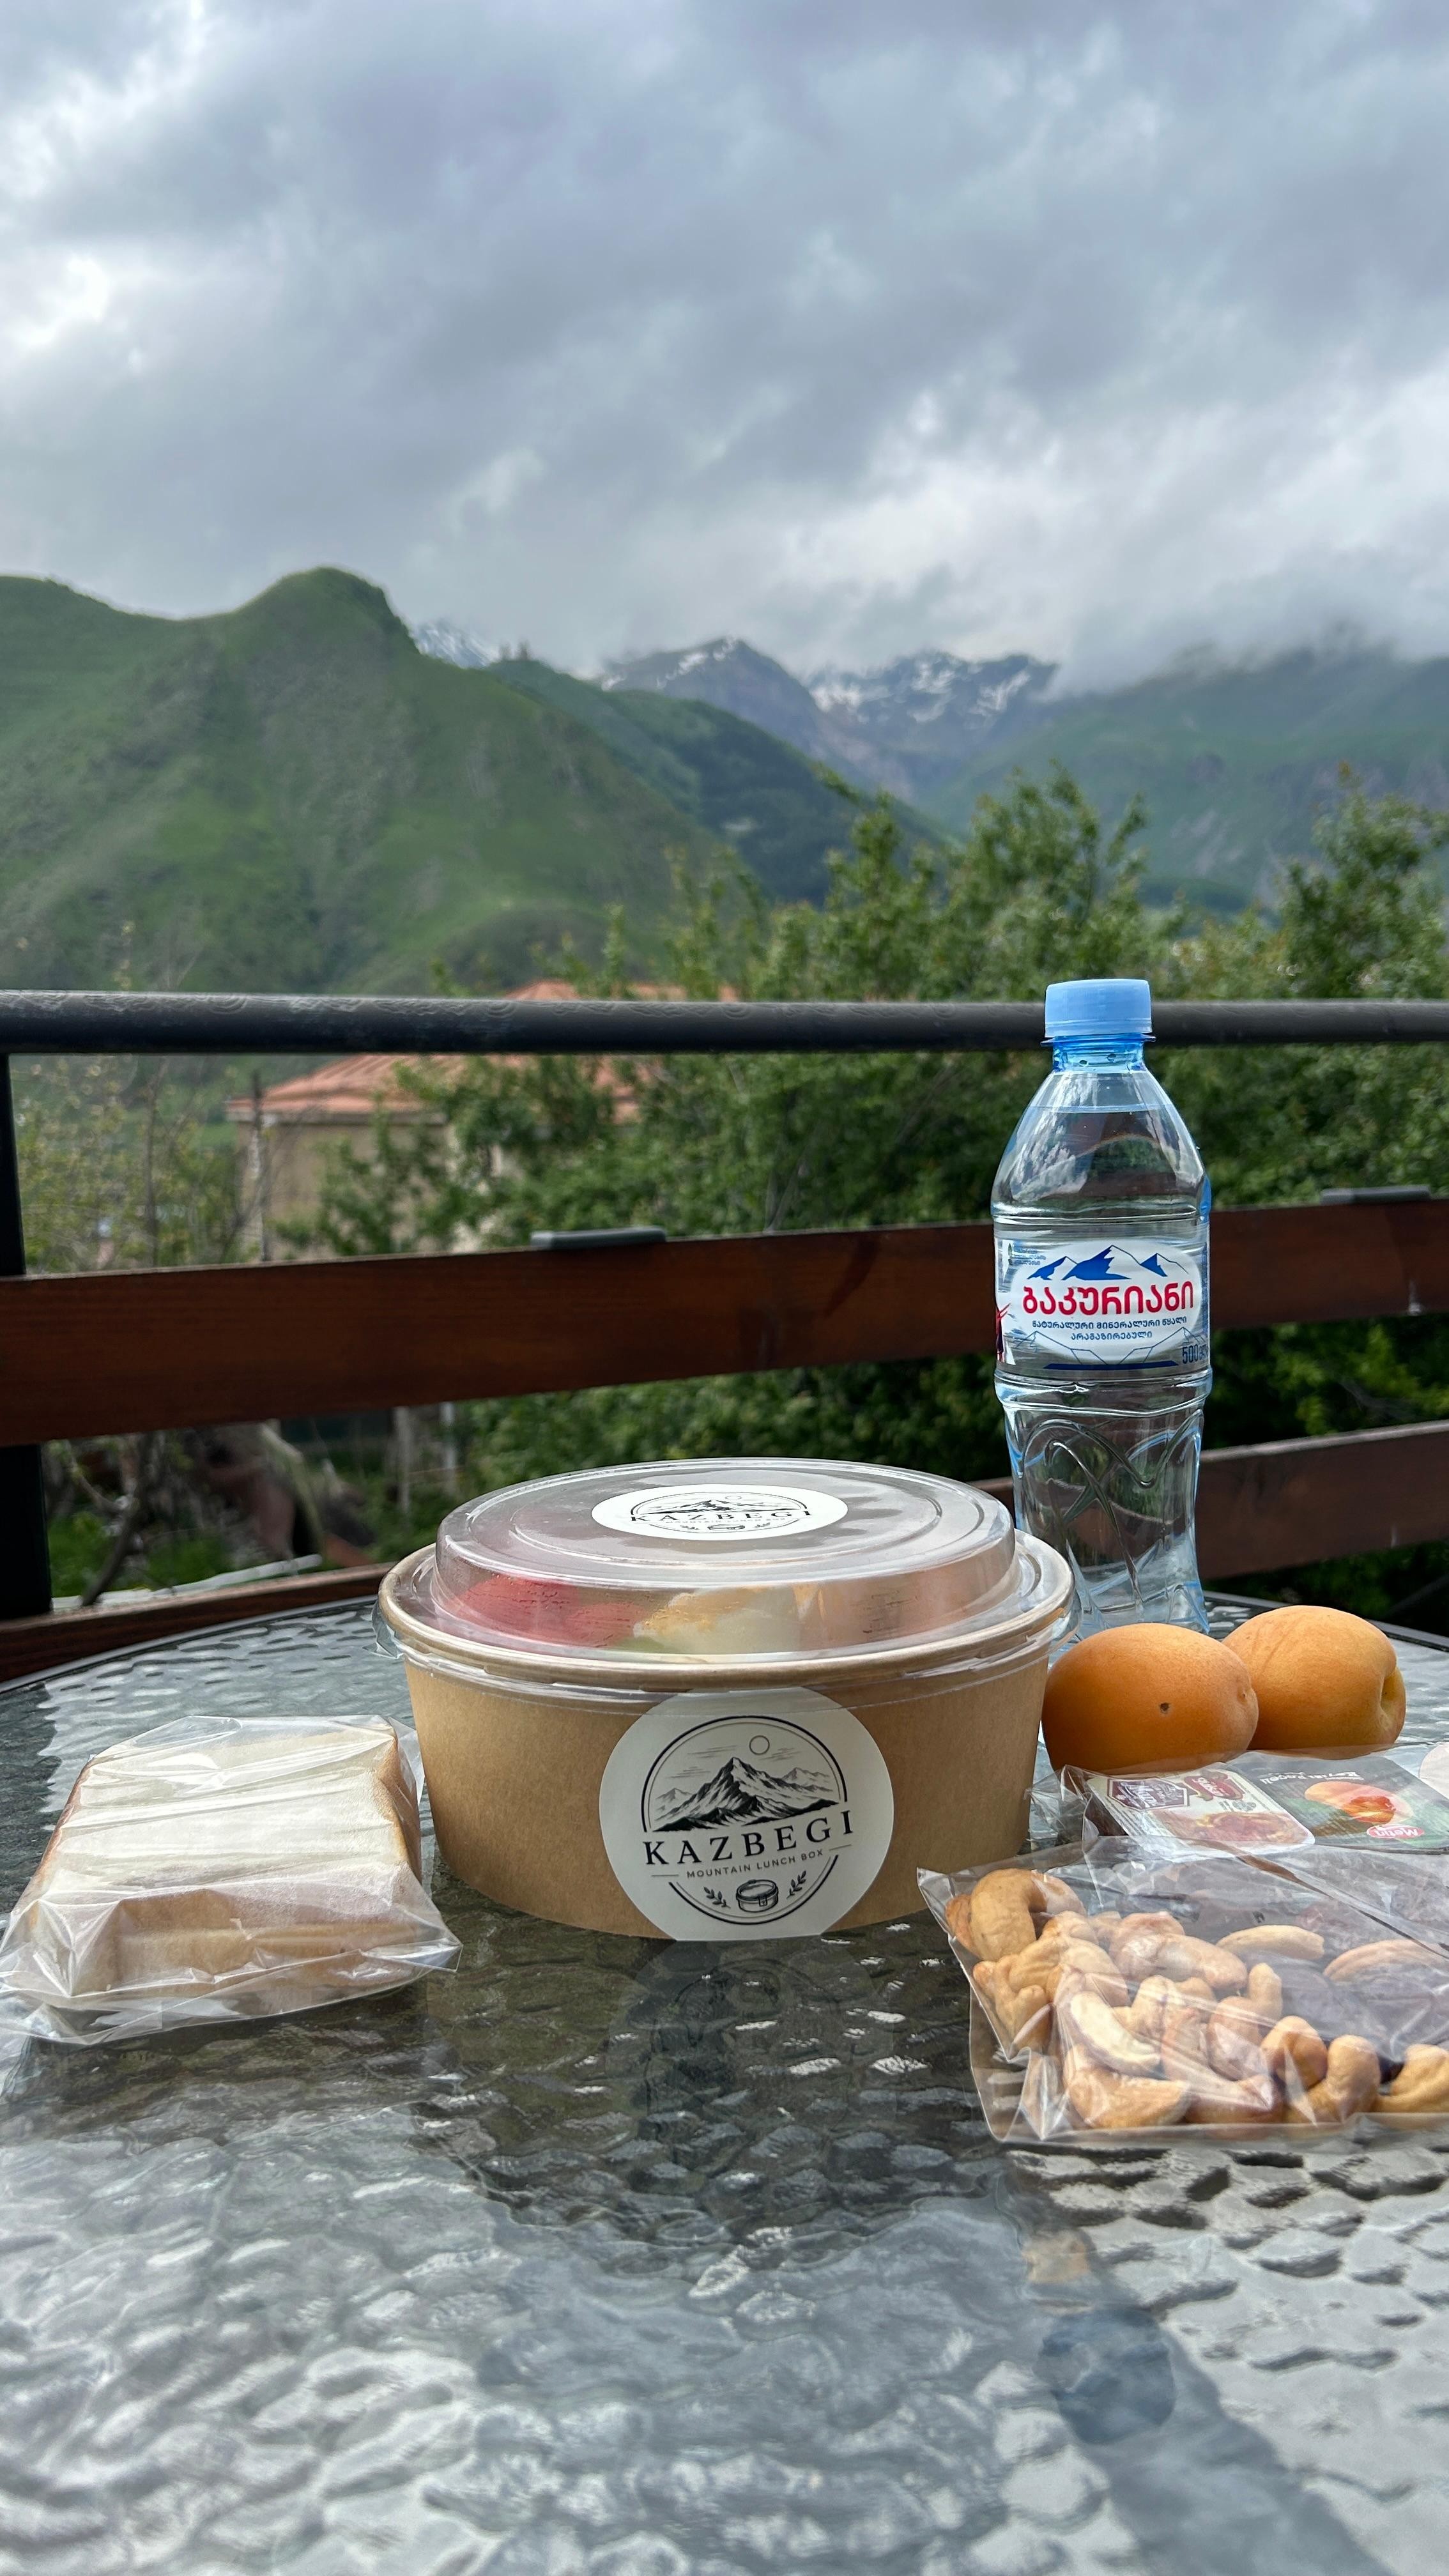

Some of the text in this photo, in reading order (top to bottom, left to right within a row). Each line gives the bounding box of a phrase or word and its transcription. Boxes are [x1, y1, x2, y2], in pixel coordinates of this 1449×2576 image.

[1022, 1281, 1193, 1316] ბაკურიანი
[1032, 1315, 1187, 1330] ნატურალური მინერალური წყალი
[1070, 1331, 1153, 1341] არაგაზირებული
[631, 1510, 811, 1522] KAZBEGI
[642, 1809, 854, 1866] KAZBEGI
[686, 1849, 824, 1879] MOUNTAIN LUNCH BOX
